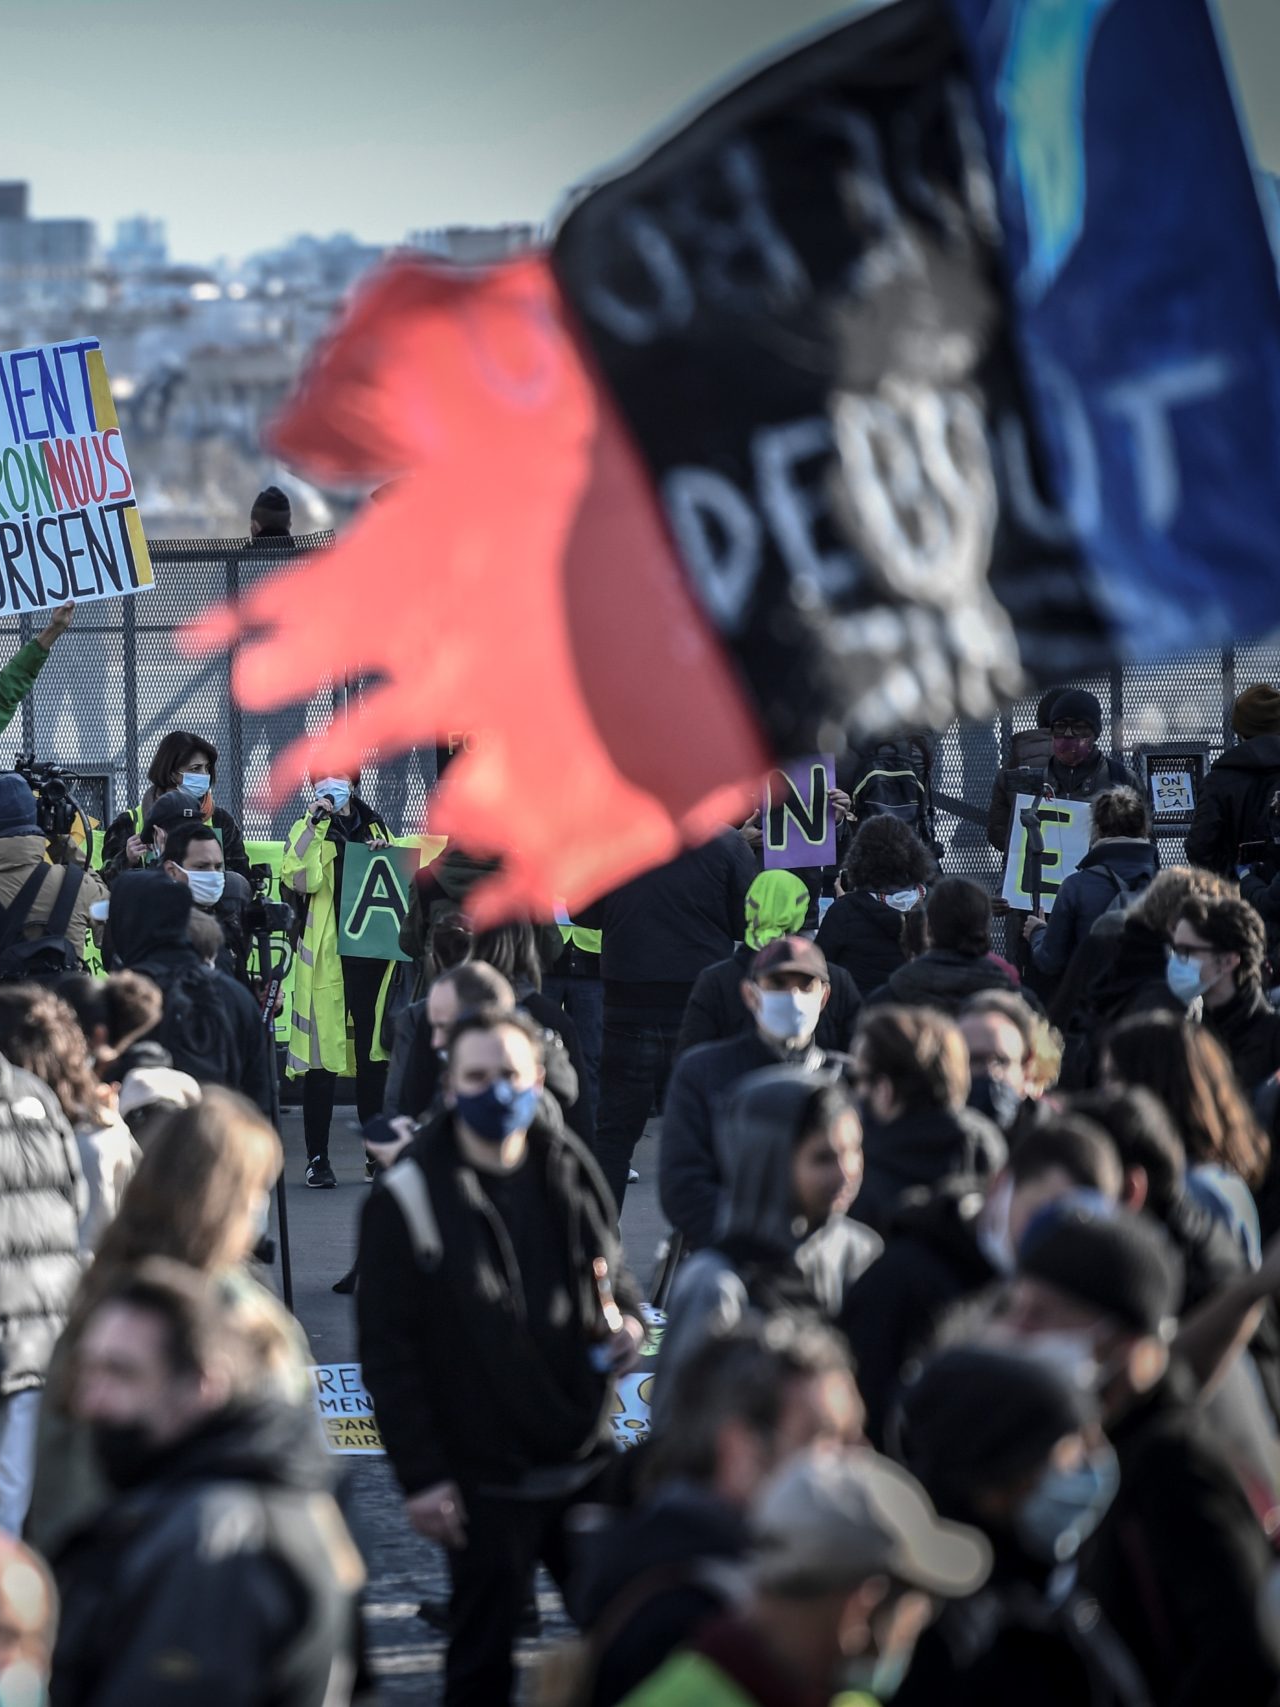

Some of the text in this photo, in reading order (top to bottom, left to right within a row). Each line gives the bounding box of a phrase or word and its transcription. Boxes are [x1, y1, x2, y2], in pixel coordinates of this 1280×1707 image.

[766, 764, 828, 851] N
[1156, 787, 1187, 798] EST
[1161, 775, 1181, 786] ON
[1016, 805, 1072, 896] E
[344, 855, 410, 940] A
